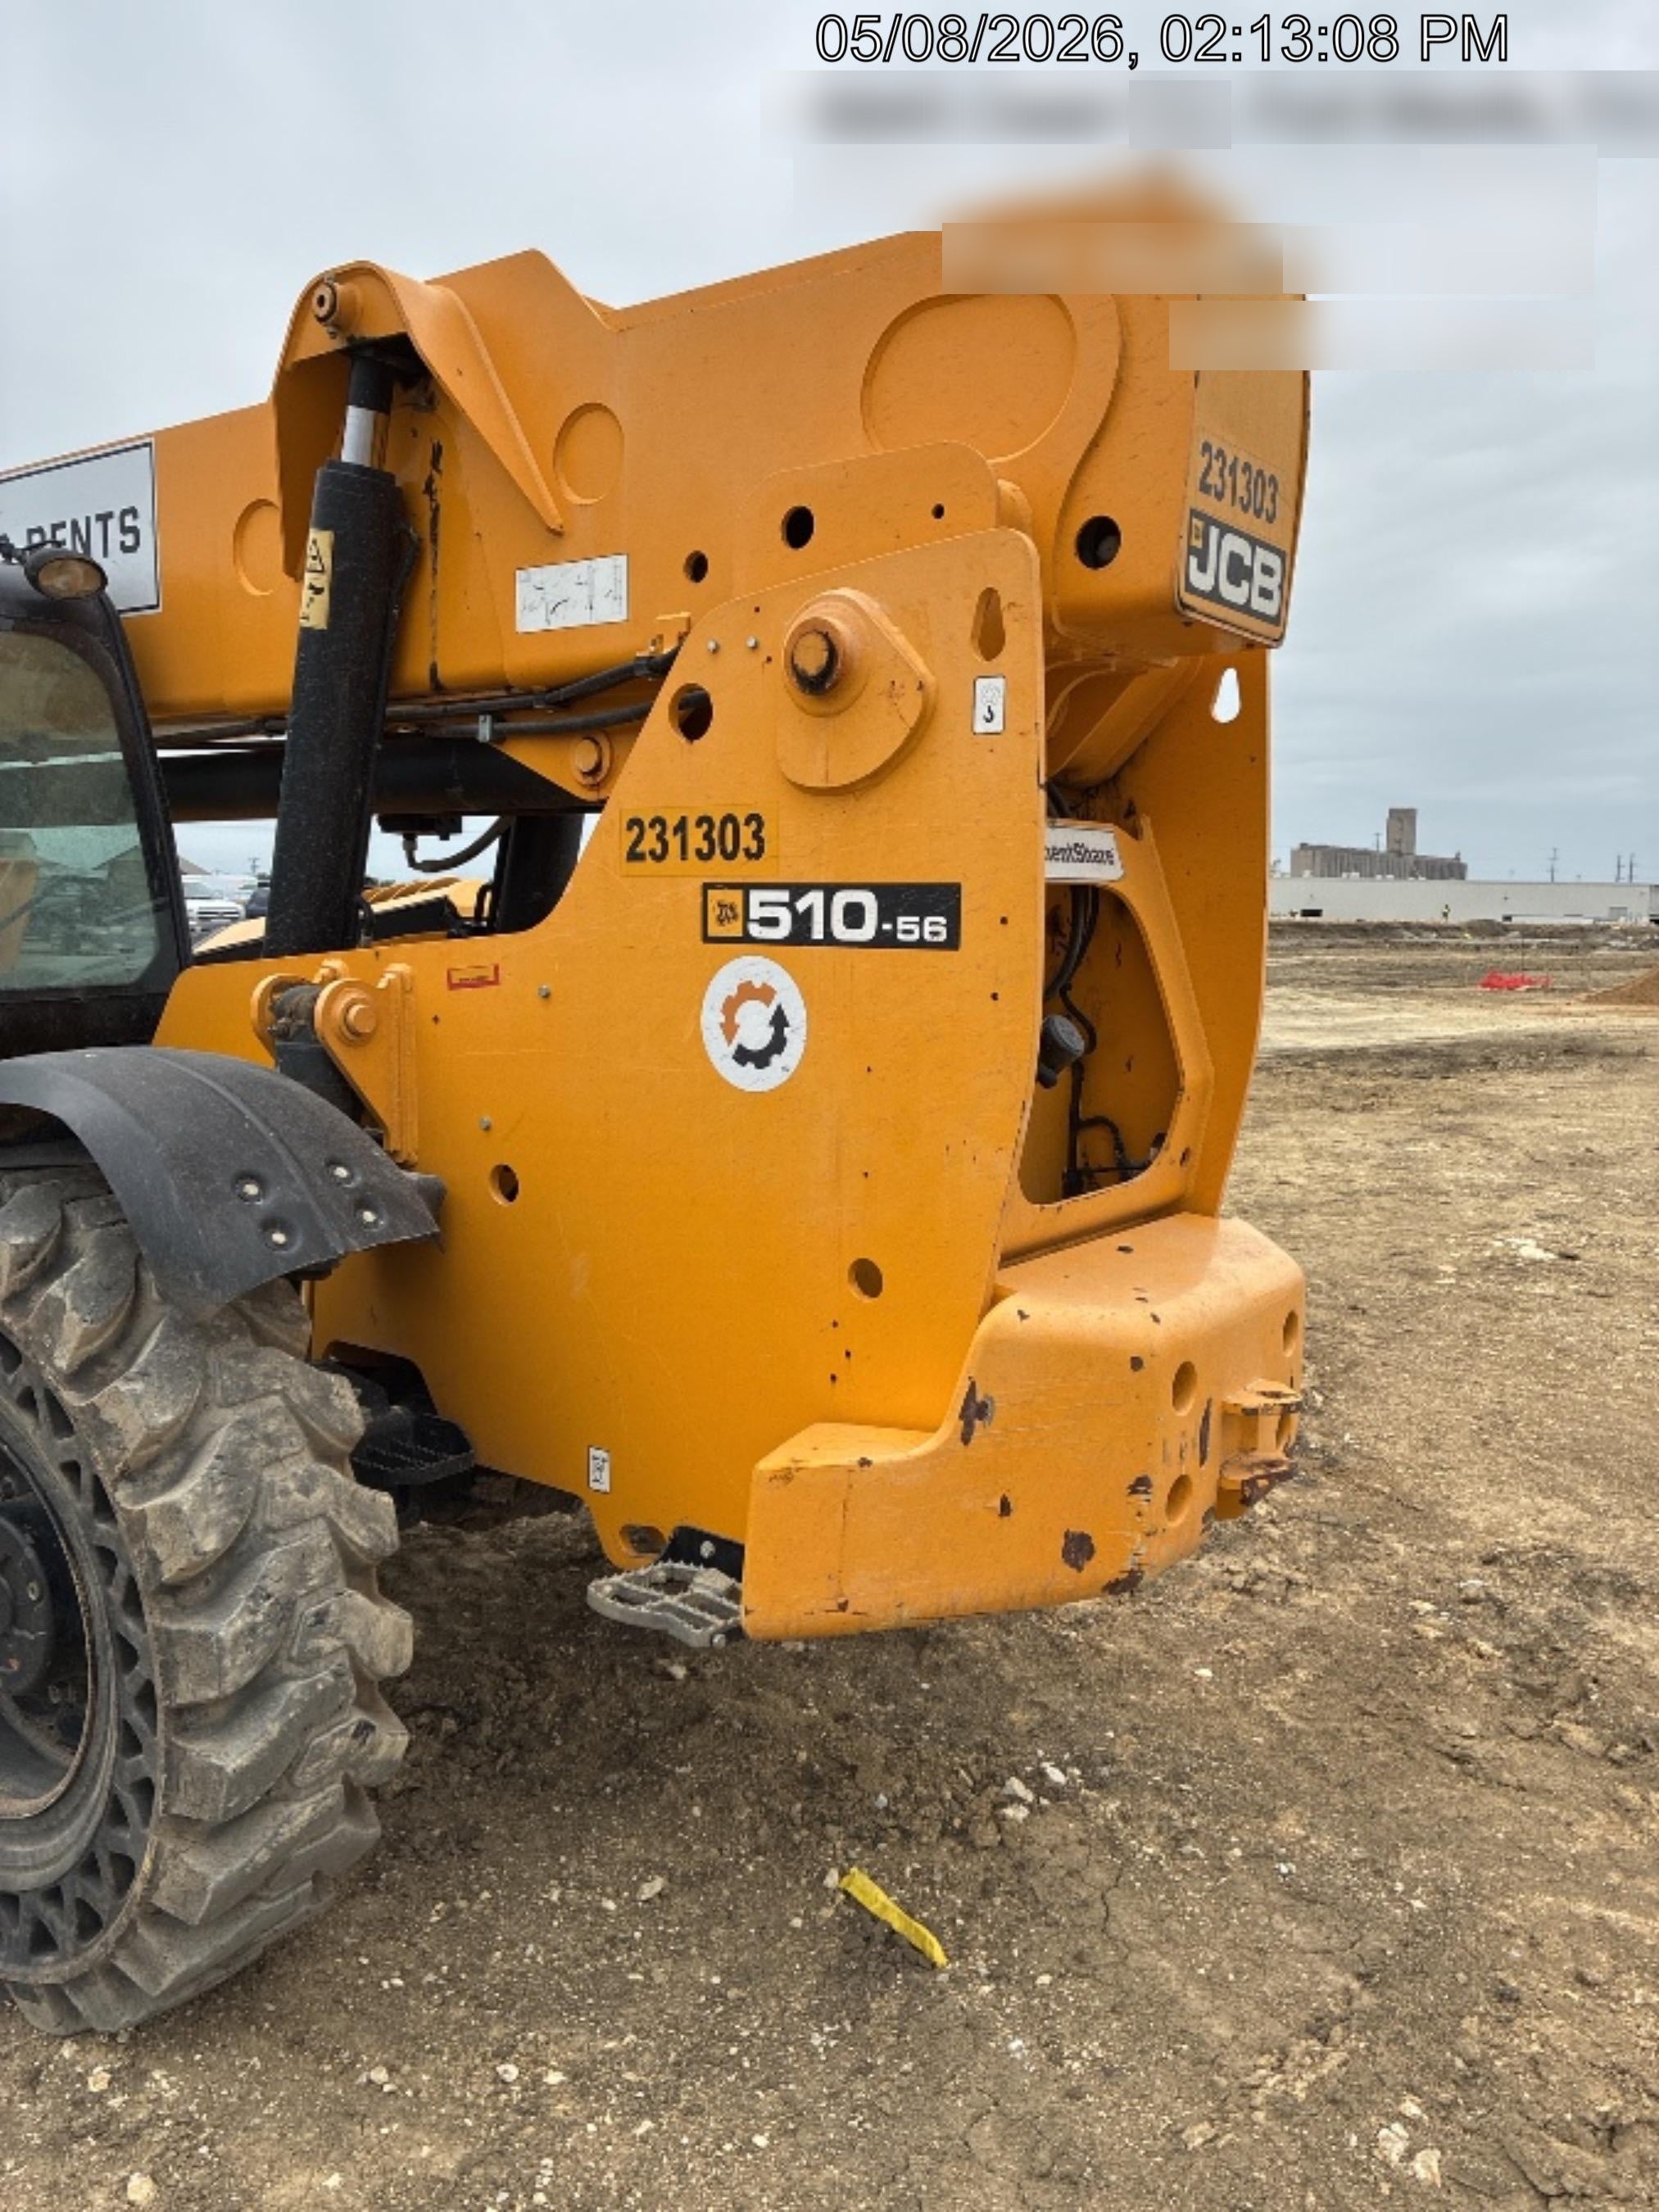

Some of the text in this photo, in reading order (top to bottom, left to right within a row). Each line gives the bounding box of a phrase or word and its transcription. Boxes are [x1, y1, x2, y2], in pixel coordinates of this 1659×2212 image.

[1199, 439, 1279, 524] 231303
[1189, 524, 1283, 618] JCB
[626, 813, 765, 863] 231303
[746, 889, 948, 942] 510-56
